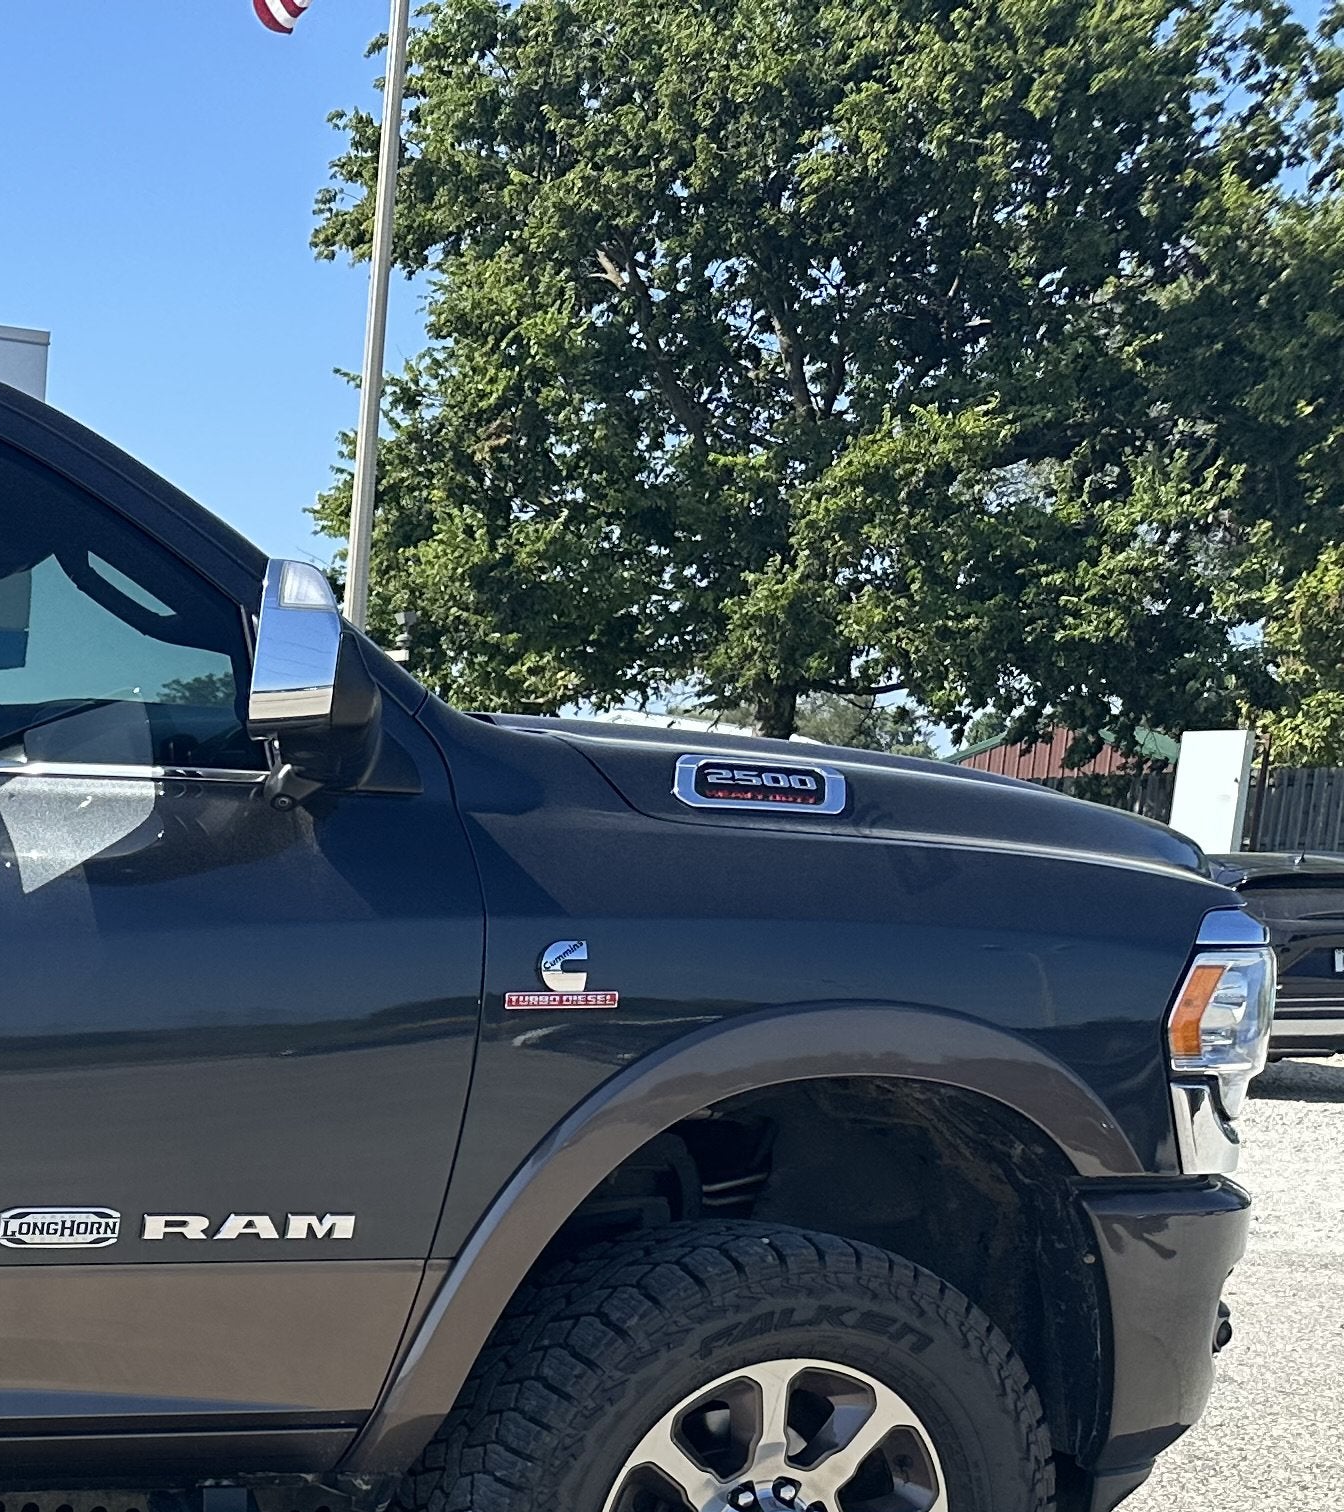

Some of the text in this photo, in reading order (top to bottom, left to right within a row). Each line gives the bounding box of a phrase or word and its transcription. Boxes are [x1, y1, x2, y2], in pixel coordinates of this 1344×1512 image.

[704, 768, 817, 790] 2500
[543, 940, 584, 971] Cummins
[509, 994, 615, 1006] TURBO DIESEL
[141, 1212, 357, 1240] RAM
